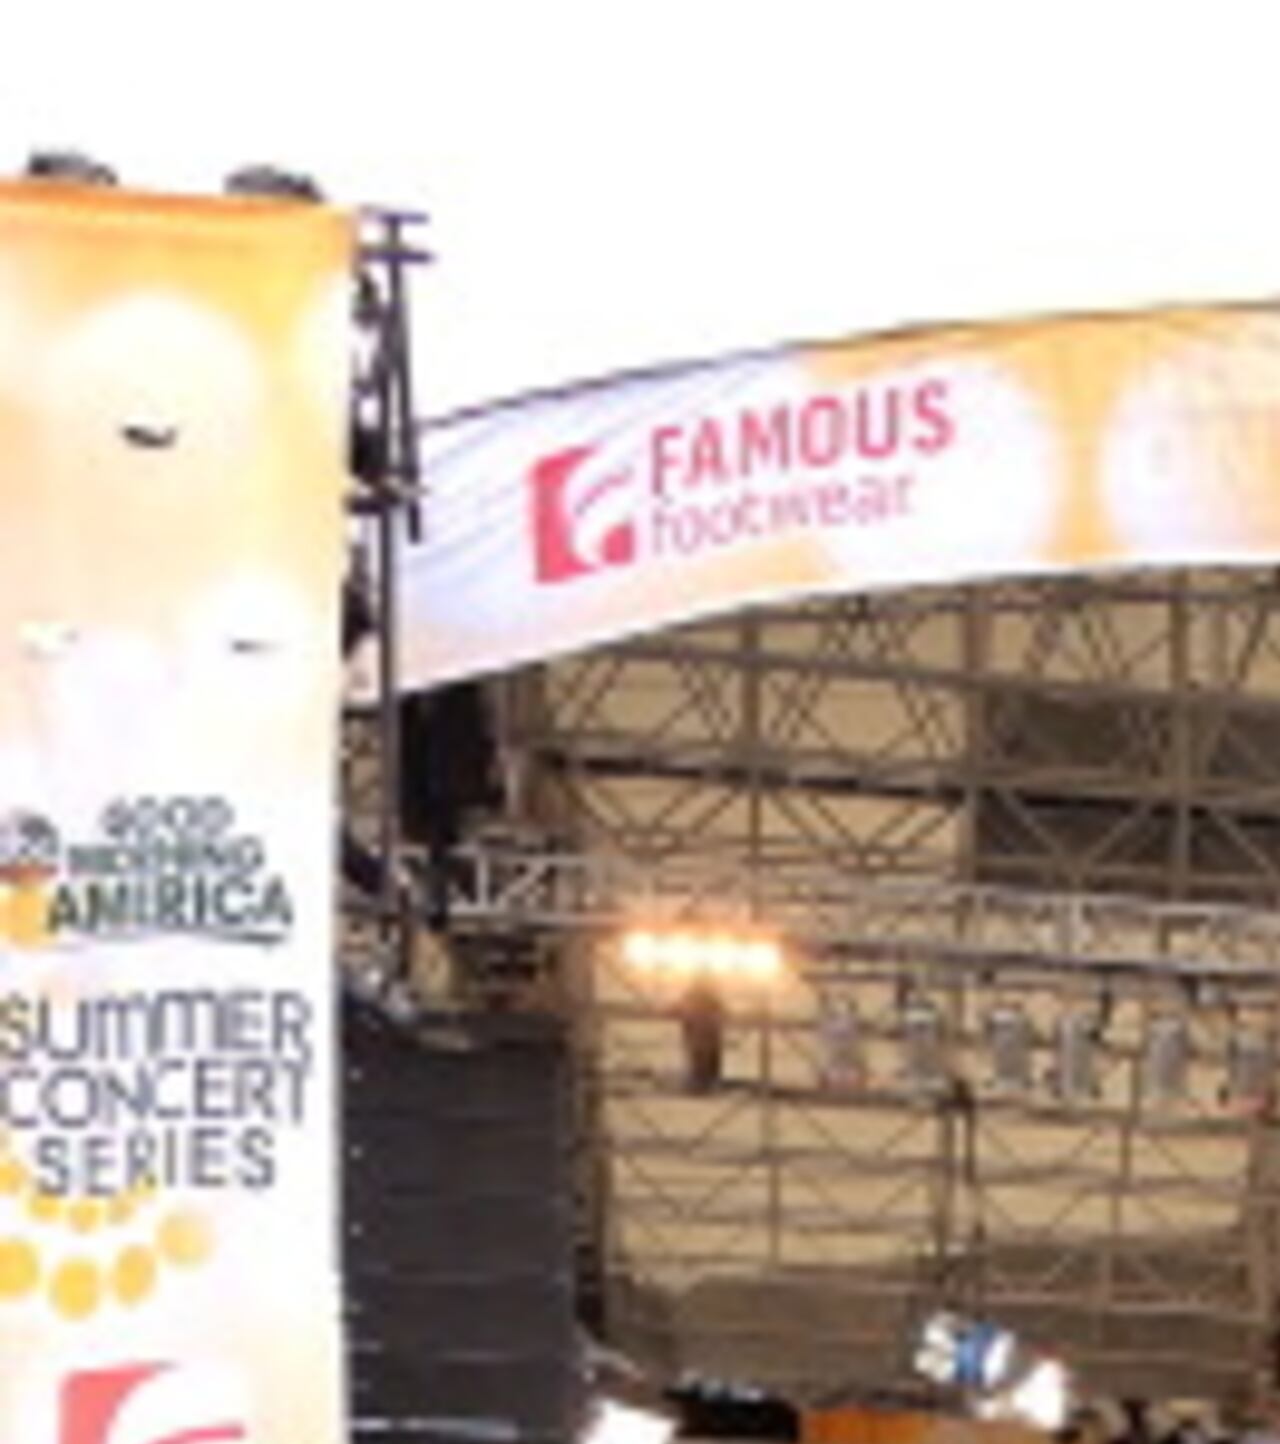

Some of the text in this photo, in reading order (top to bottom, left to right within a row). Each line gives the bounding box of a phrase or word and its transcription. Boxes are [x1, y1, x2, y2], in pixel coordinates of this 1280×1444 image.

[650, 377, 957, 498] FAMOUS
[46, 873, 294, 934] AMERICA
[0, 988, 313, 1062] SUMMER
[0, 1055, 312, 1129] CONCERT
[35, 1128, 276, 1195] SERIES
